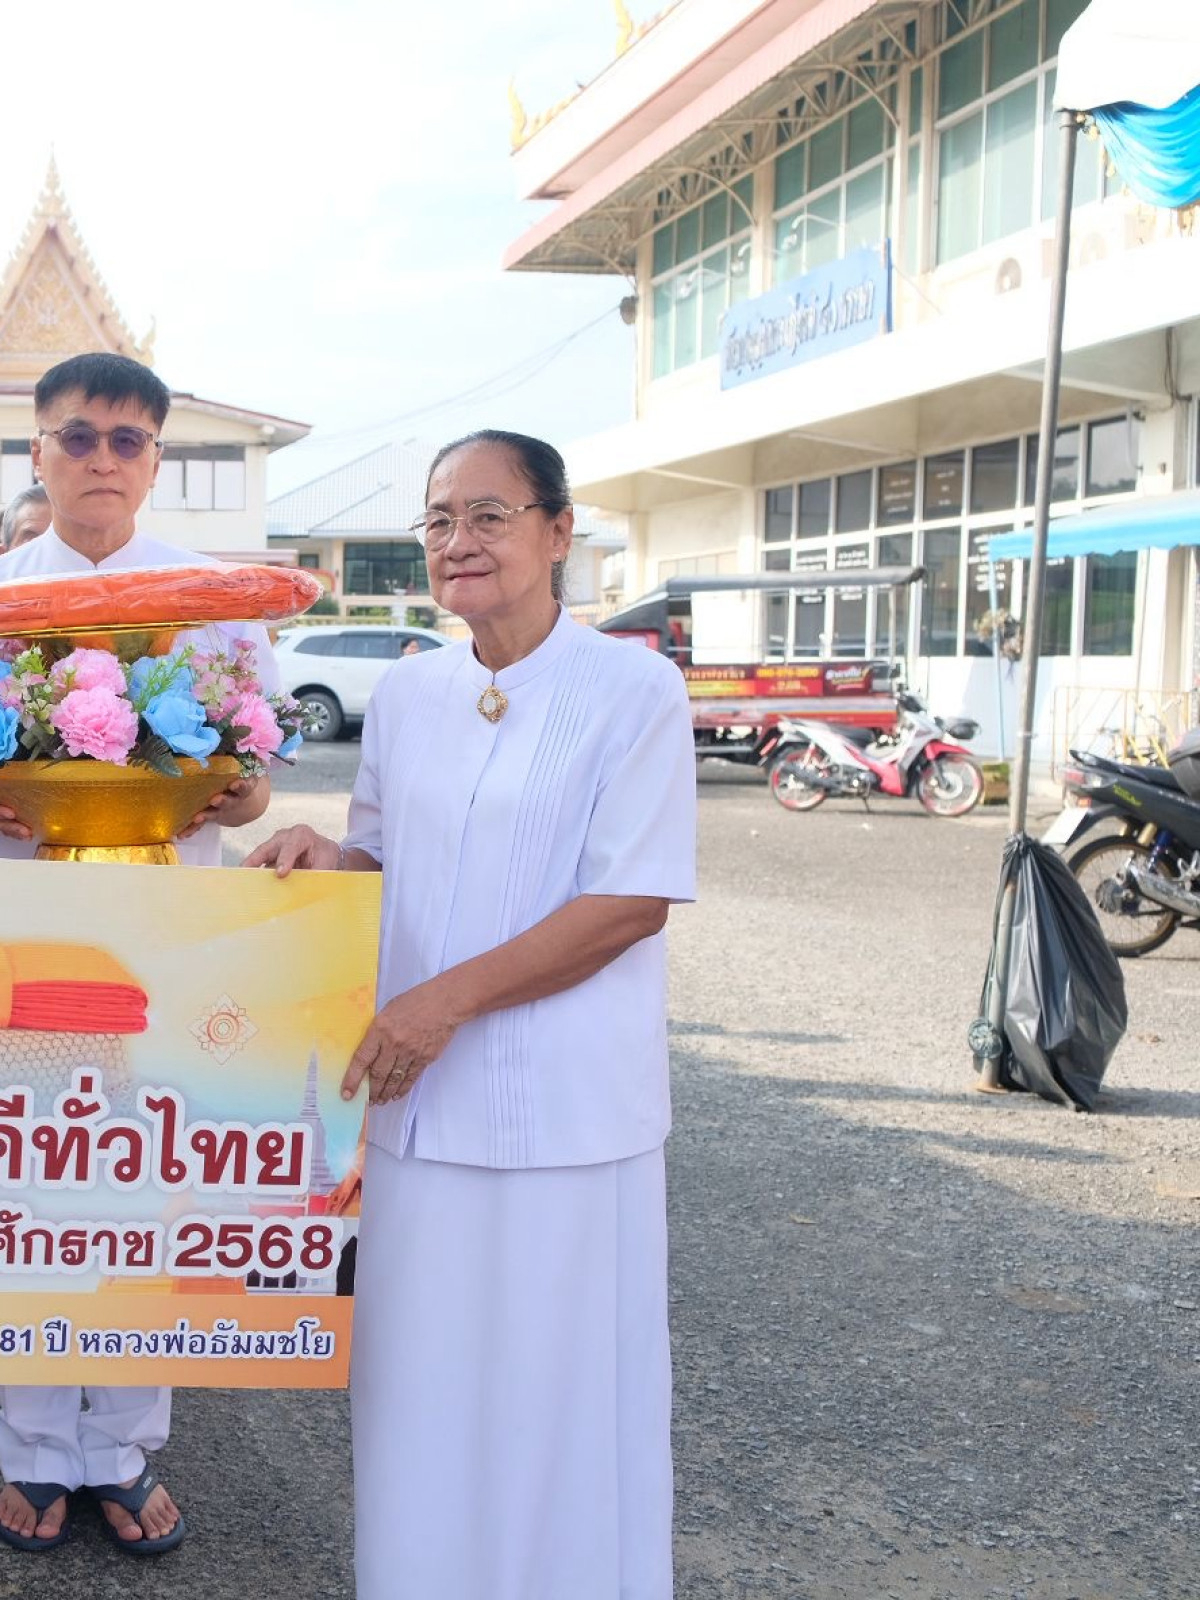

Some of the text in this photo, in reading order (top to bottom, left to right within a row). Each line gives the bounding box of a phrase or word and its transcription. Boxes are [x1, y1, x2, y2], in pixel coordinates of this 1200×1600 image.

[175, 1223, 334, 1270] 2568
[0, 1329, 33, 1353] 81
[44, 1319, 68, 1353] ปี
[79, 1319, 332, 1356] หลวงพ่อธัมมชโย
